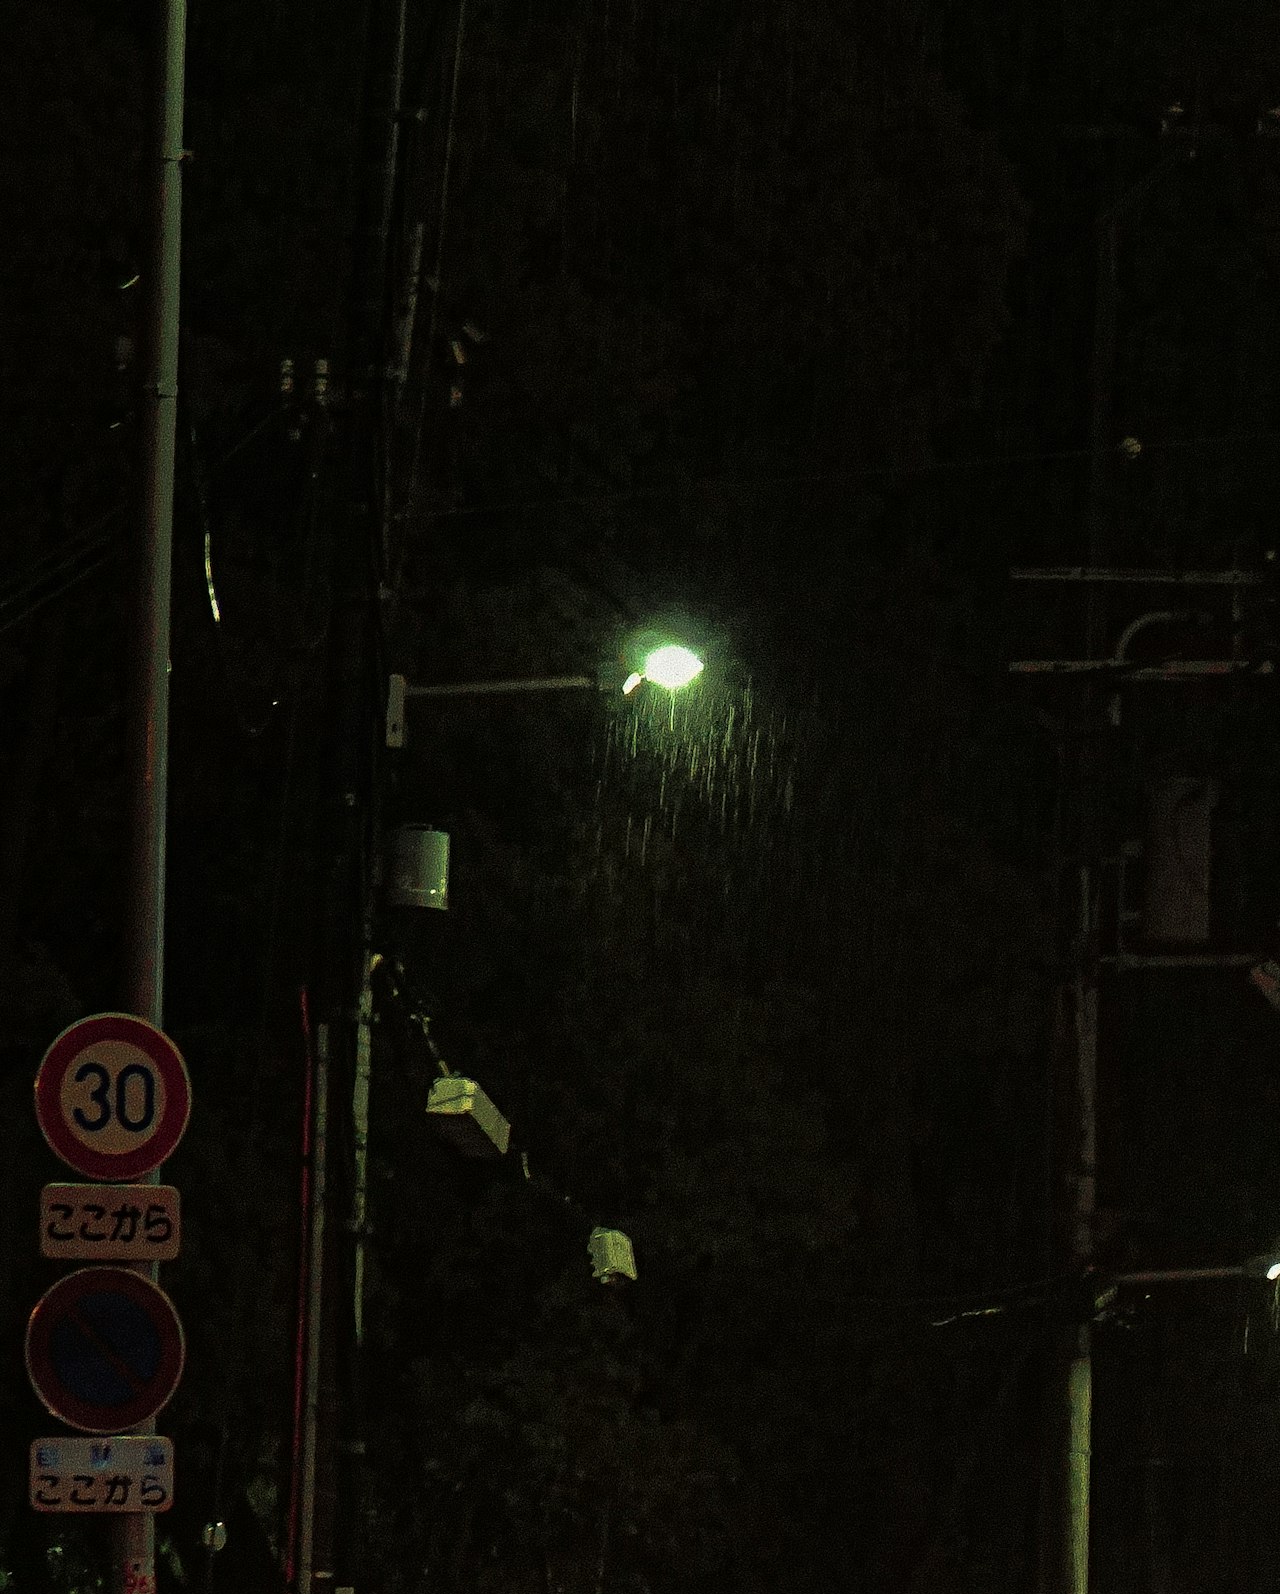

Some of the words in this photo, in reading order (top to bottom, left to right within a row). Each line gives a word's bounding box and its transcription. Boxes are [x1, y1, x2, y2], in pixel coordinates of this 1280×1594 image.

[73, 1062, 155, 1133] 30
[46, 1202, 173, 1244] ここから
[35, 1474, 167, 1506] ここから
